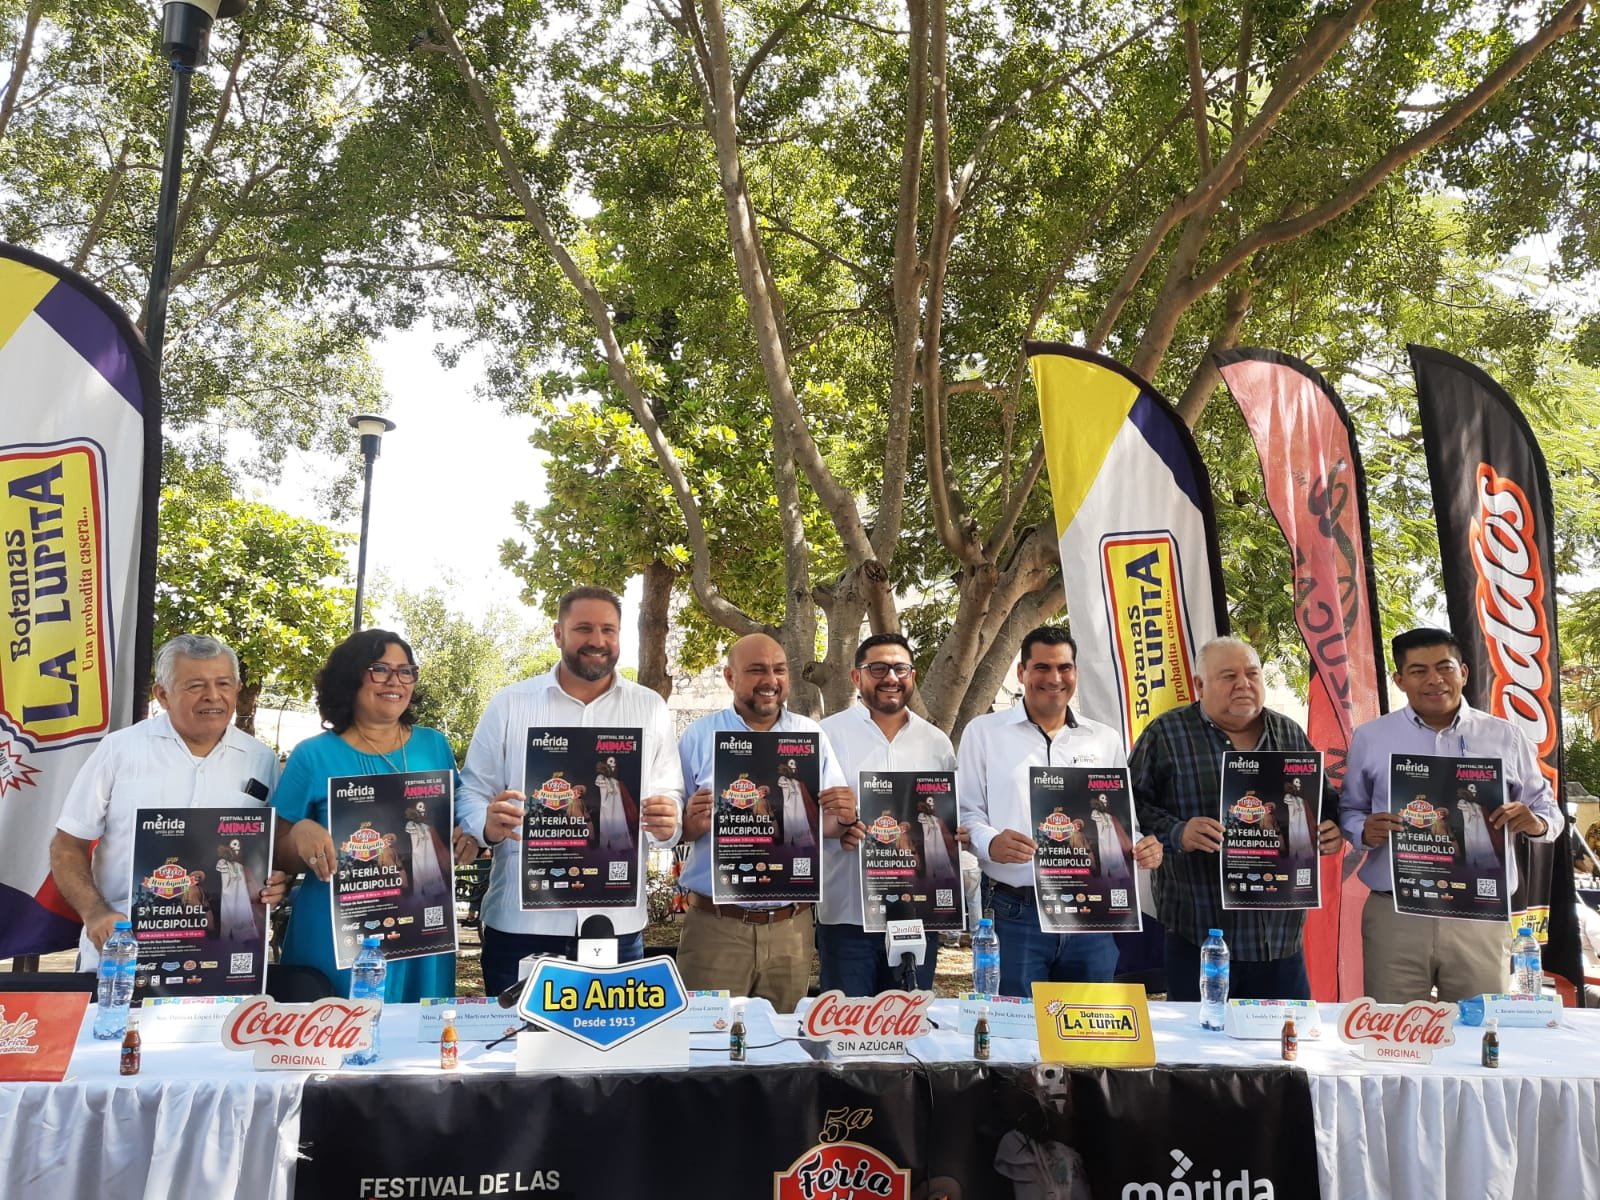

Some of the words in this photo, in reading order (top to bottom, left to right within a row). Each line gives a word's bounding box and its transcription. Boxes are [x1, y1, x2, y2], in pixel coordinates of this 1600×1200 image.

[76, 506, 92, 566] casera...
[8, 461, 72, 625] LUPITA
[6, 529, 31, 663] Botanas
[78, 568, 94, 641] probadita
[1125, 547, 1166, 692] LUPITA
[1164, 588, 1178, 640] casera...
[81, 642, 95, 672] Una
[1128, 604, 1150, 719] Botanas
[1169, 642, 1188, 703] probadita
[22, 648, 79, 726] LA
[541, 815, 568, 825] FERIA
[570, 816, 587, 825] DEL
[729, 814, 754, 824] FERIA
[756, 815, 772, 824] DEL
[529, 829, 590, 838] MUCBIPOLLO
[718, 826, 775, 836] MUCBIPOLLO
[1238, 828, 1262, 837] FERIA
[1263, 829, 1278, 838] DEL
[1227, 839, 1280, 848] MUCBIPOLLO
[1408, 832, 1433, 842] FERIA
[1435, 834, 1452, 843] DEL
[875, 848, 898, 857] FERIA
[898, 849, 914, 857] DEL
[1049, 847, 1073, 855] FERIA
[1073, 847, 1088, 855] DEL
[1397, 842, 1455, 855] MUCBIPOLLO
[866, 859, 917, 868] MUCBIPOLLO
[1039, 858, 1092, 867] MUCBIPOLLO
[352, 867, 380, 878] FERIA
[381, 865, 400, 875] DEL
[339, 877, 403, 892] MUCBIPOLLO
[152, 905, 183, 915] FERIA
[185, 905, 206, 915] DEL
[137, 918, 208, 930] MUCBIPOLLO
[543, 980, 578, 1011] La
[584, 978, 666, 1011] Anita
[573, 1017, 607, 1028] Desde
[608, 1016, 636, 1027] 1913
[1063, 1014, 1083, 1029] LA
[1089, 1015, 1133, 1030] LUPITA
[837, 1041, 857, 1051] SIN
[859, 1039, 904, 1051] AZÚCAR
[1377, 1048, 1421, 1059] ORIGINAL
[271, 1055, 328, 1066] ORIGINAL
[799, 1151, 892, 1200] Feria
[359, 1174, 473, 1198] FESTIVAL
[479, 1172, 510, 1193] DE
[515, 1170, 561, 1192] LAS
